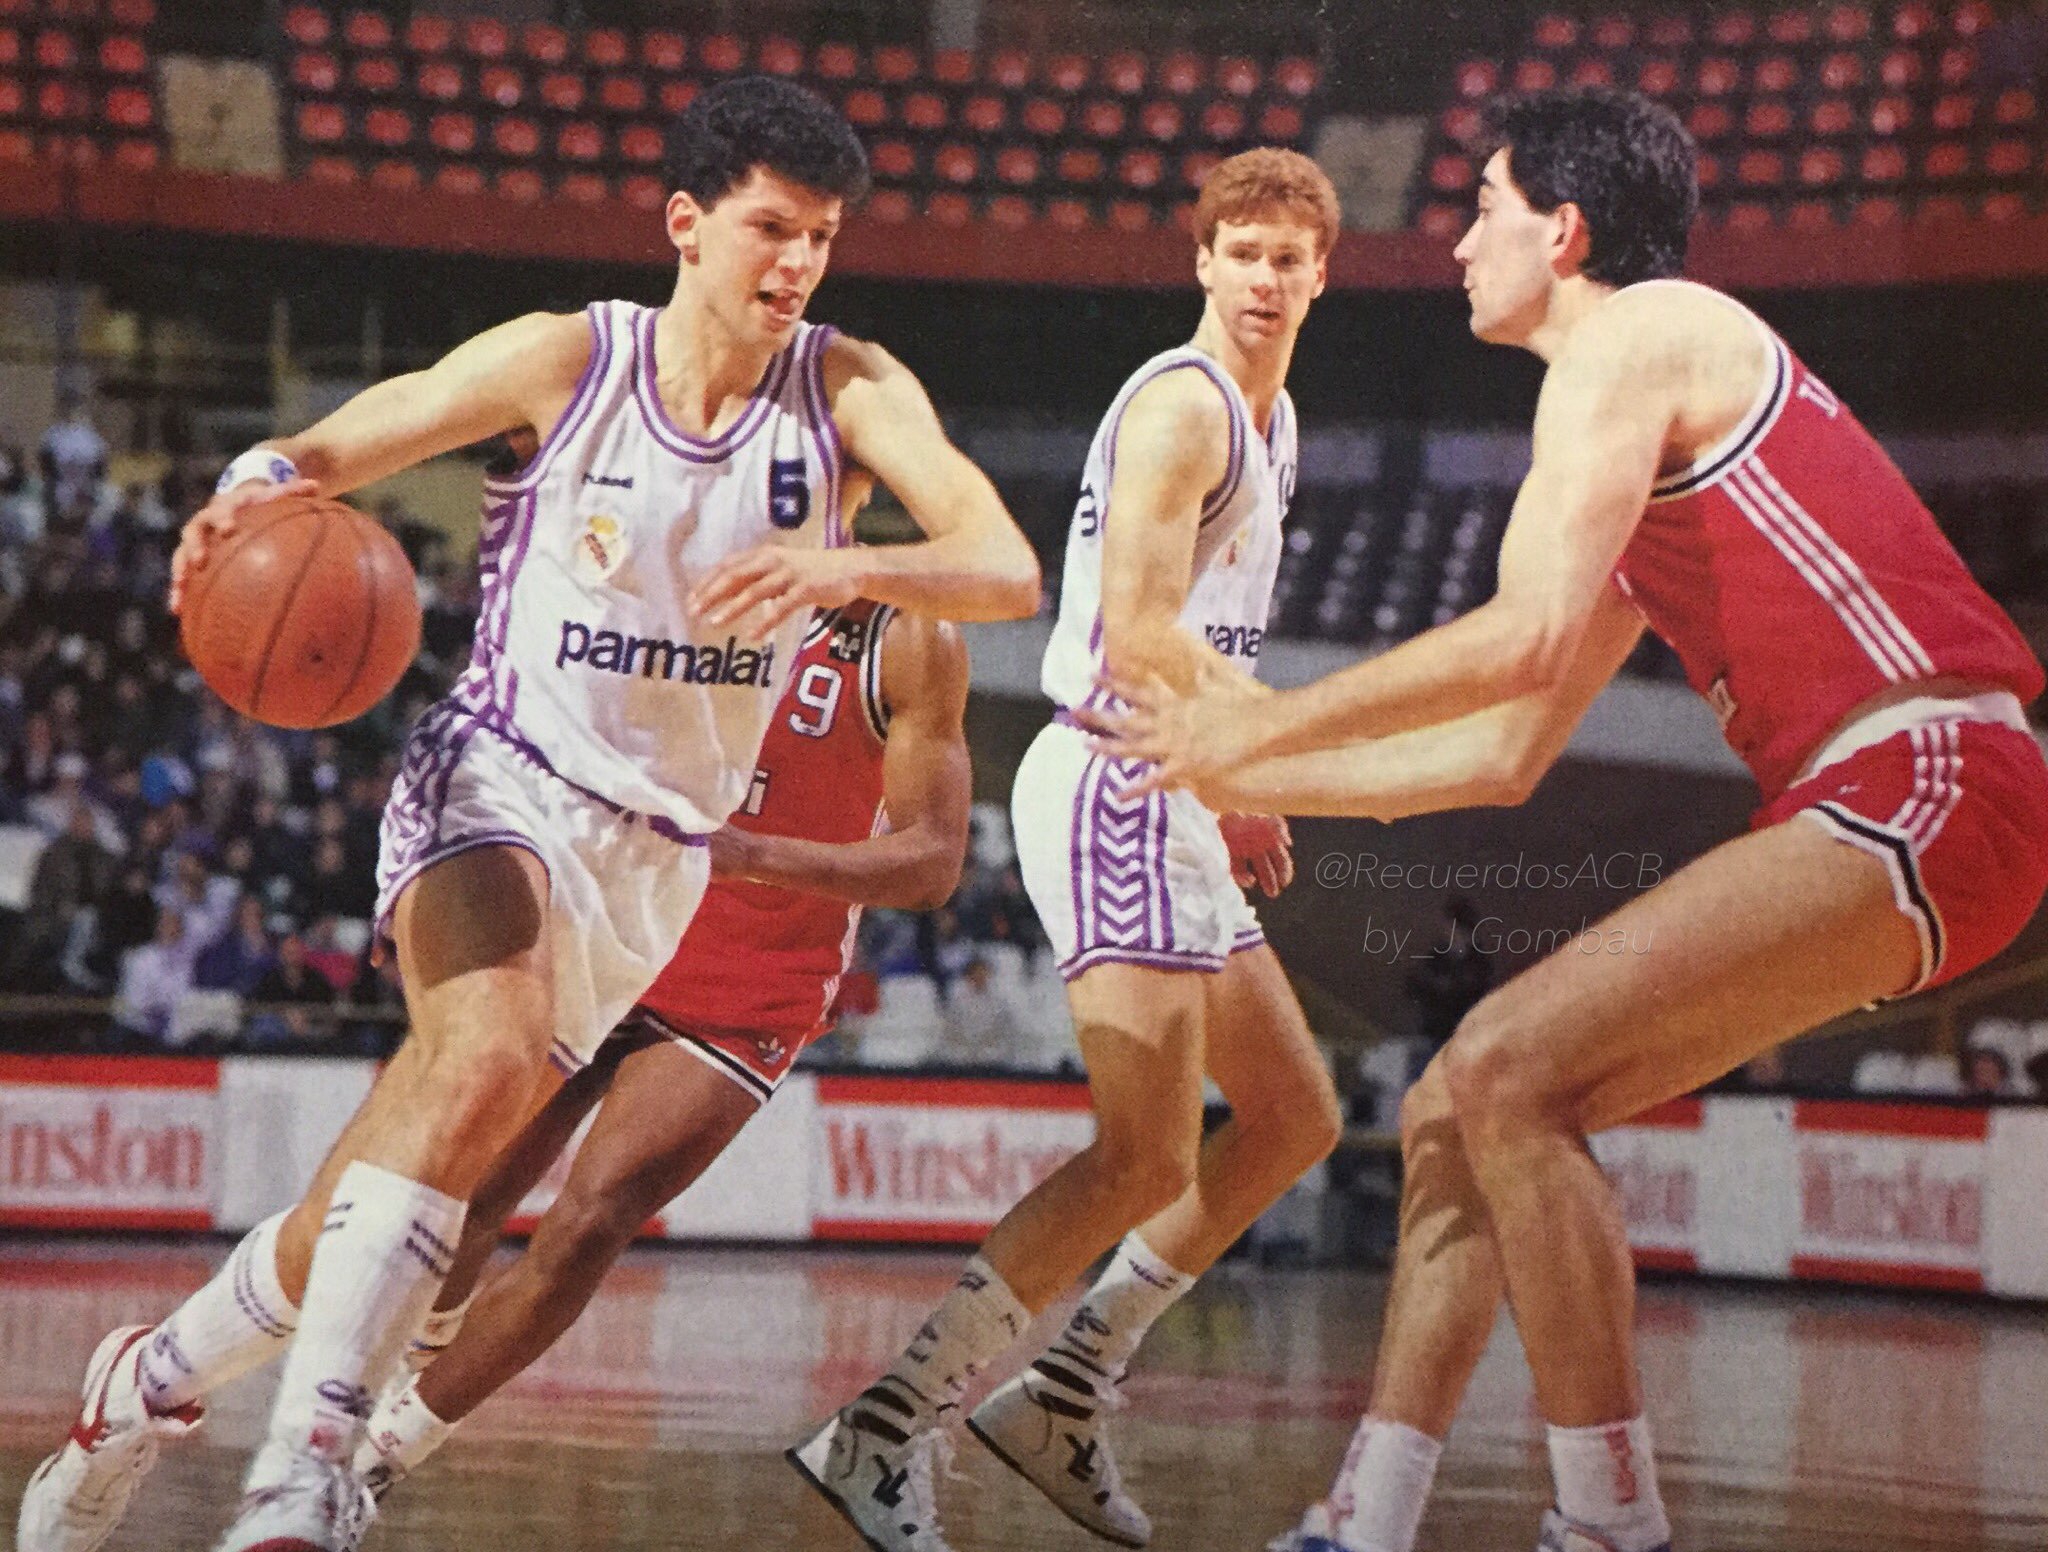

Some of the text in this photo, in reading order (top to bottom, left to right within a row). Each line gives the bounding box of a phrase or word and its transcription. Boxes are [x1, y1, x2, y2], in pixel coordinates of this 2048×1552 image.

[770, 458, 810, 530] 5
[555, 618, 774, 688] parmalat
[788, 662, 843, 739] 9
